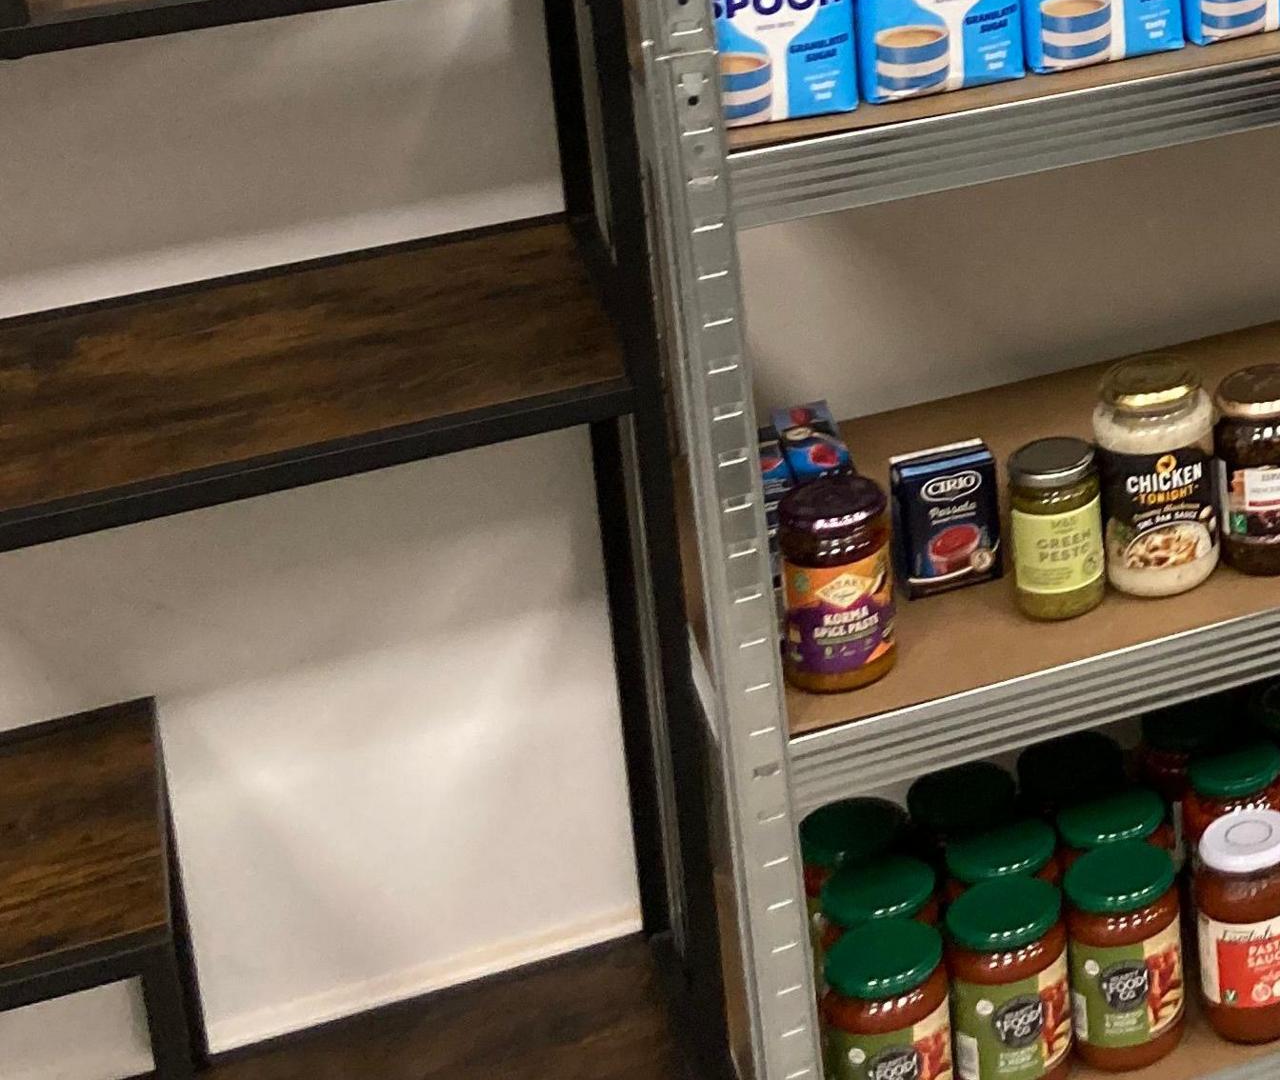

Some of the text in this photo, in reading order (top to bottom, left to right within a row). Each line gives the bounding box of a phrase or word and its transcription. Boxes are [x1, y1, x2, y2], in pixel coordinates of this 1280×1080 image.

[927, 474, 976, 494] CIRIO
[1126, 462, 1202, 494] CHICKEN
[1036, 529, 1091, 550] GREEN
[1039, 543, 1090, 562] PESTO
[1108, 977, 1145, 994] FOOD
